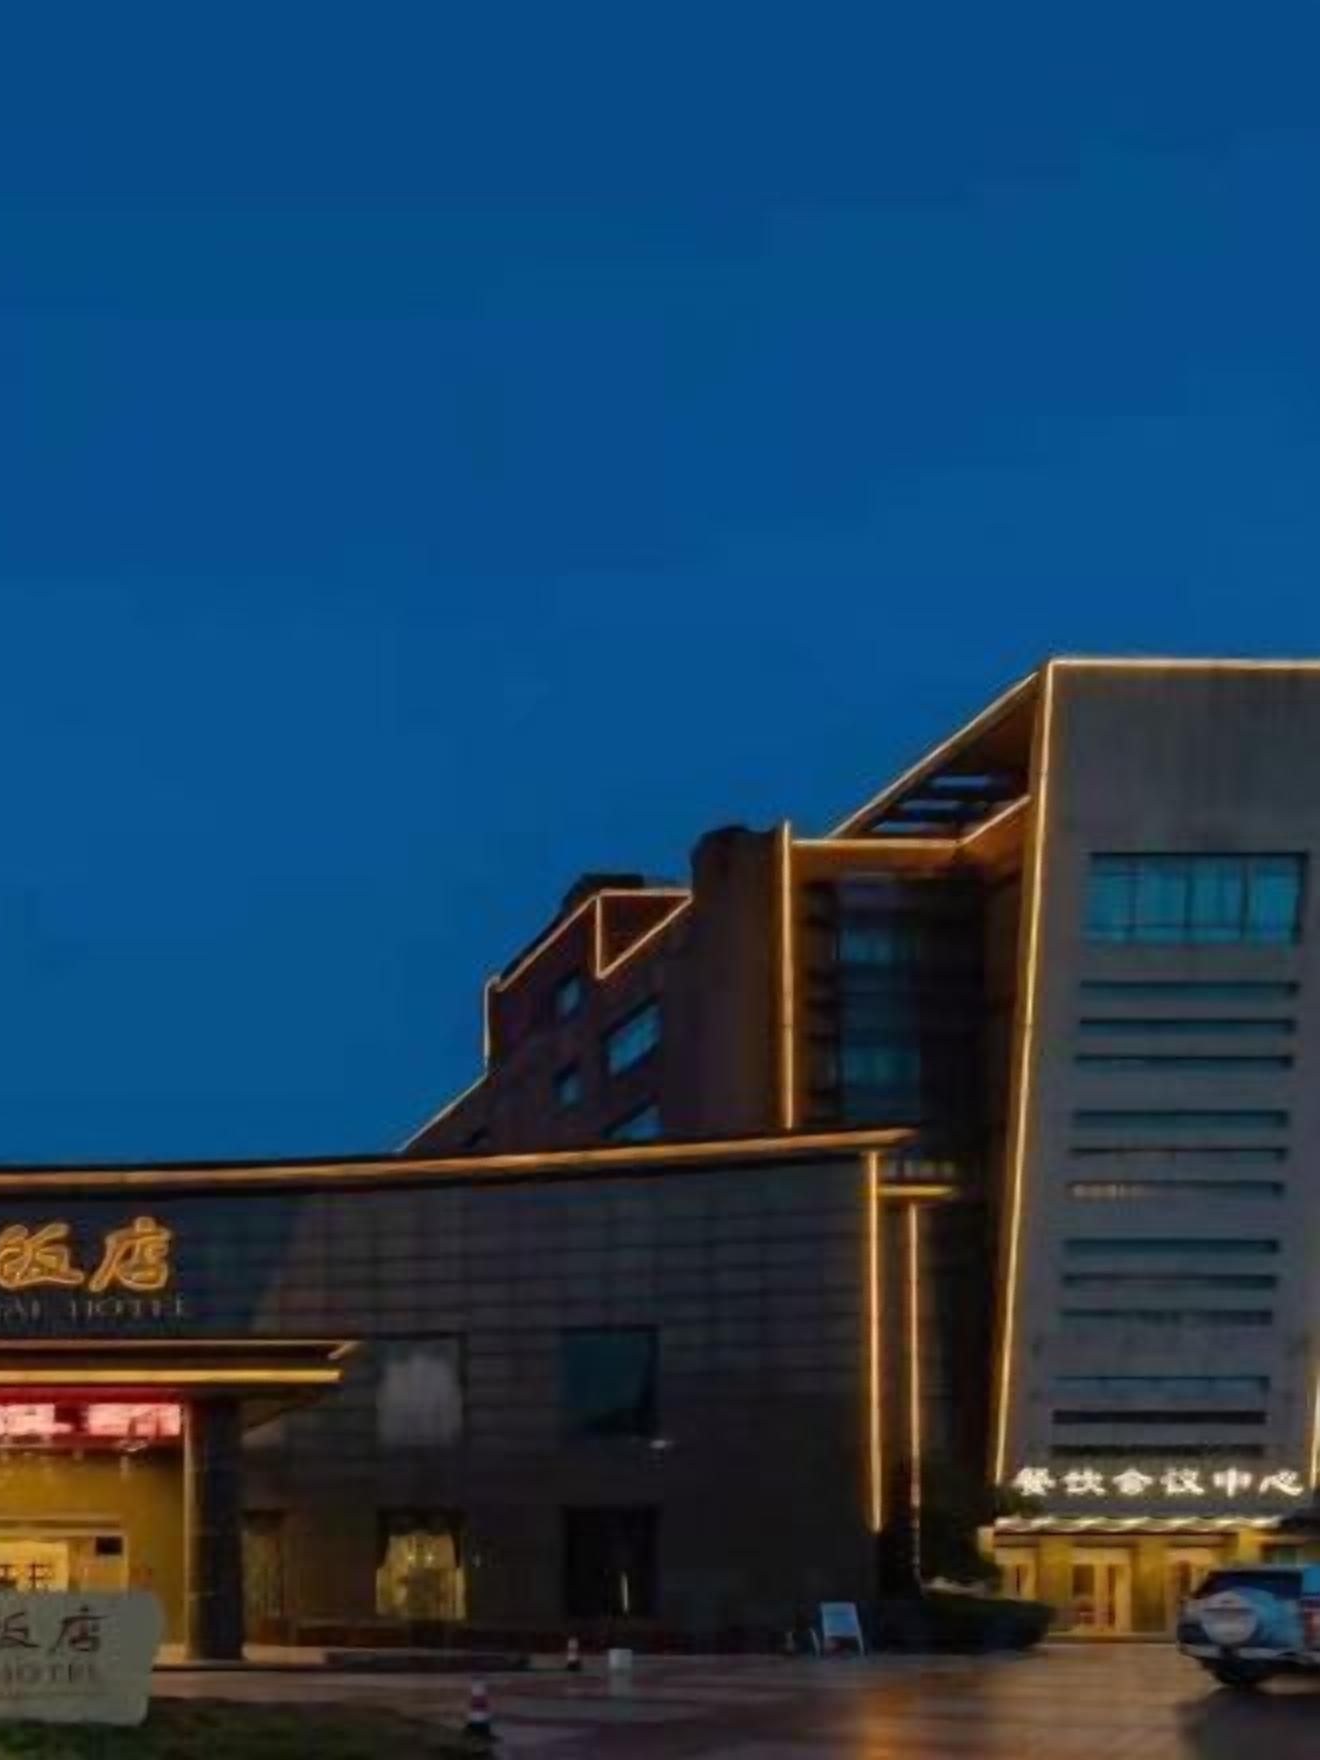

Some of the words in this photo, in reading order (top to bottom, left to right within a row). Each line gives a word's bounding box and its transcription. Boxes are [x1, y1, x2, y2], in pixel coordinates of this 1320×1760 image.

[1014, 1467, 1304, 1496] 餐饮会议中心
